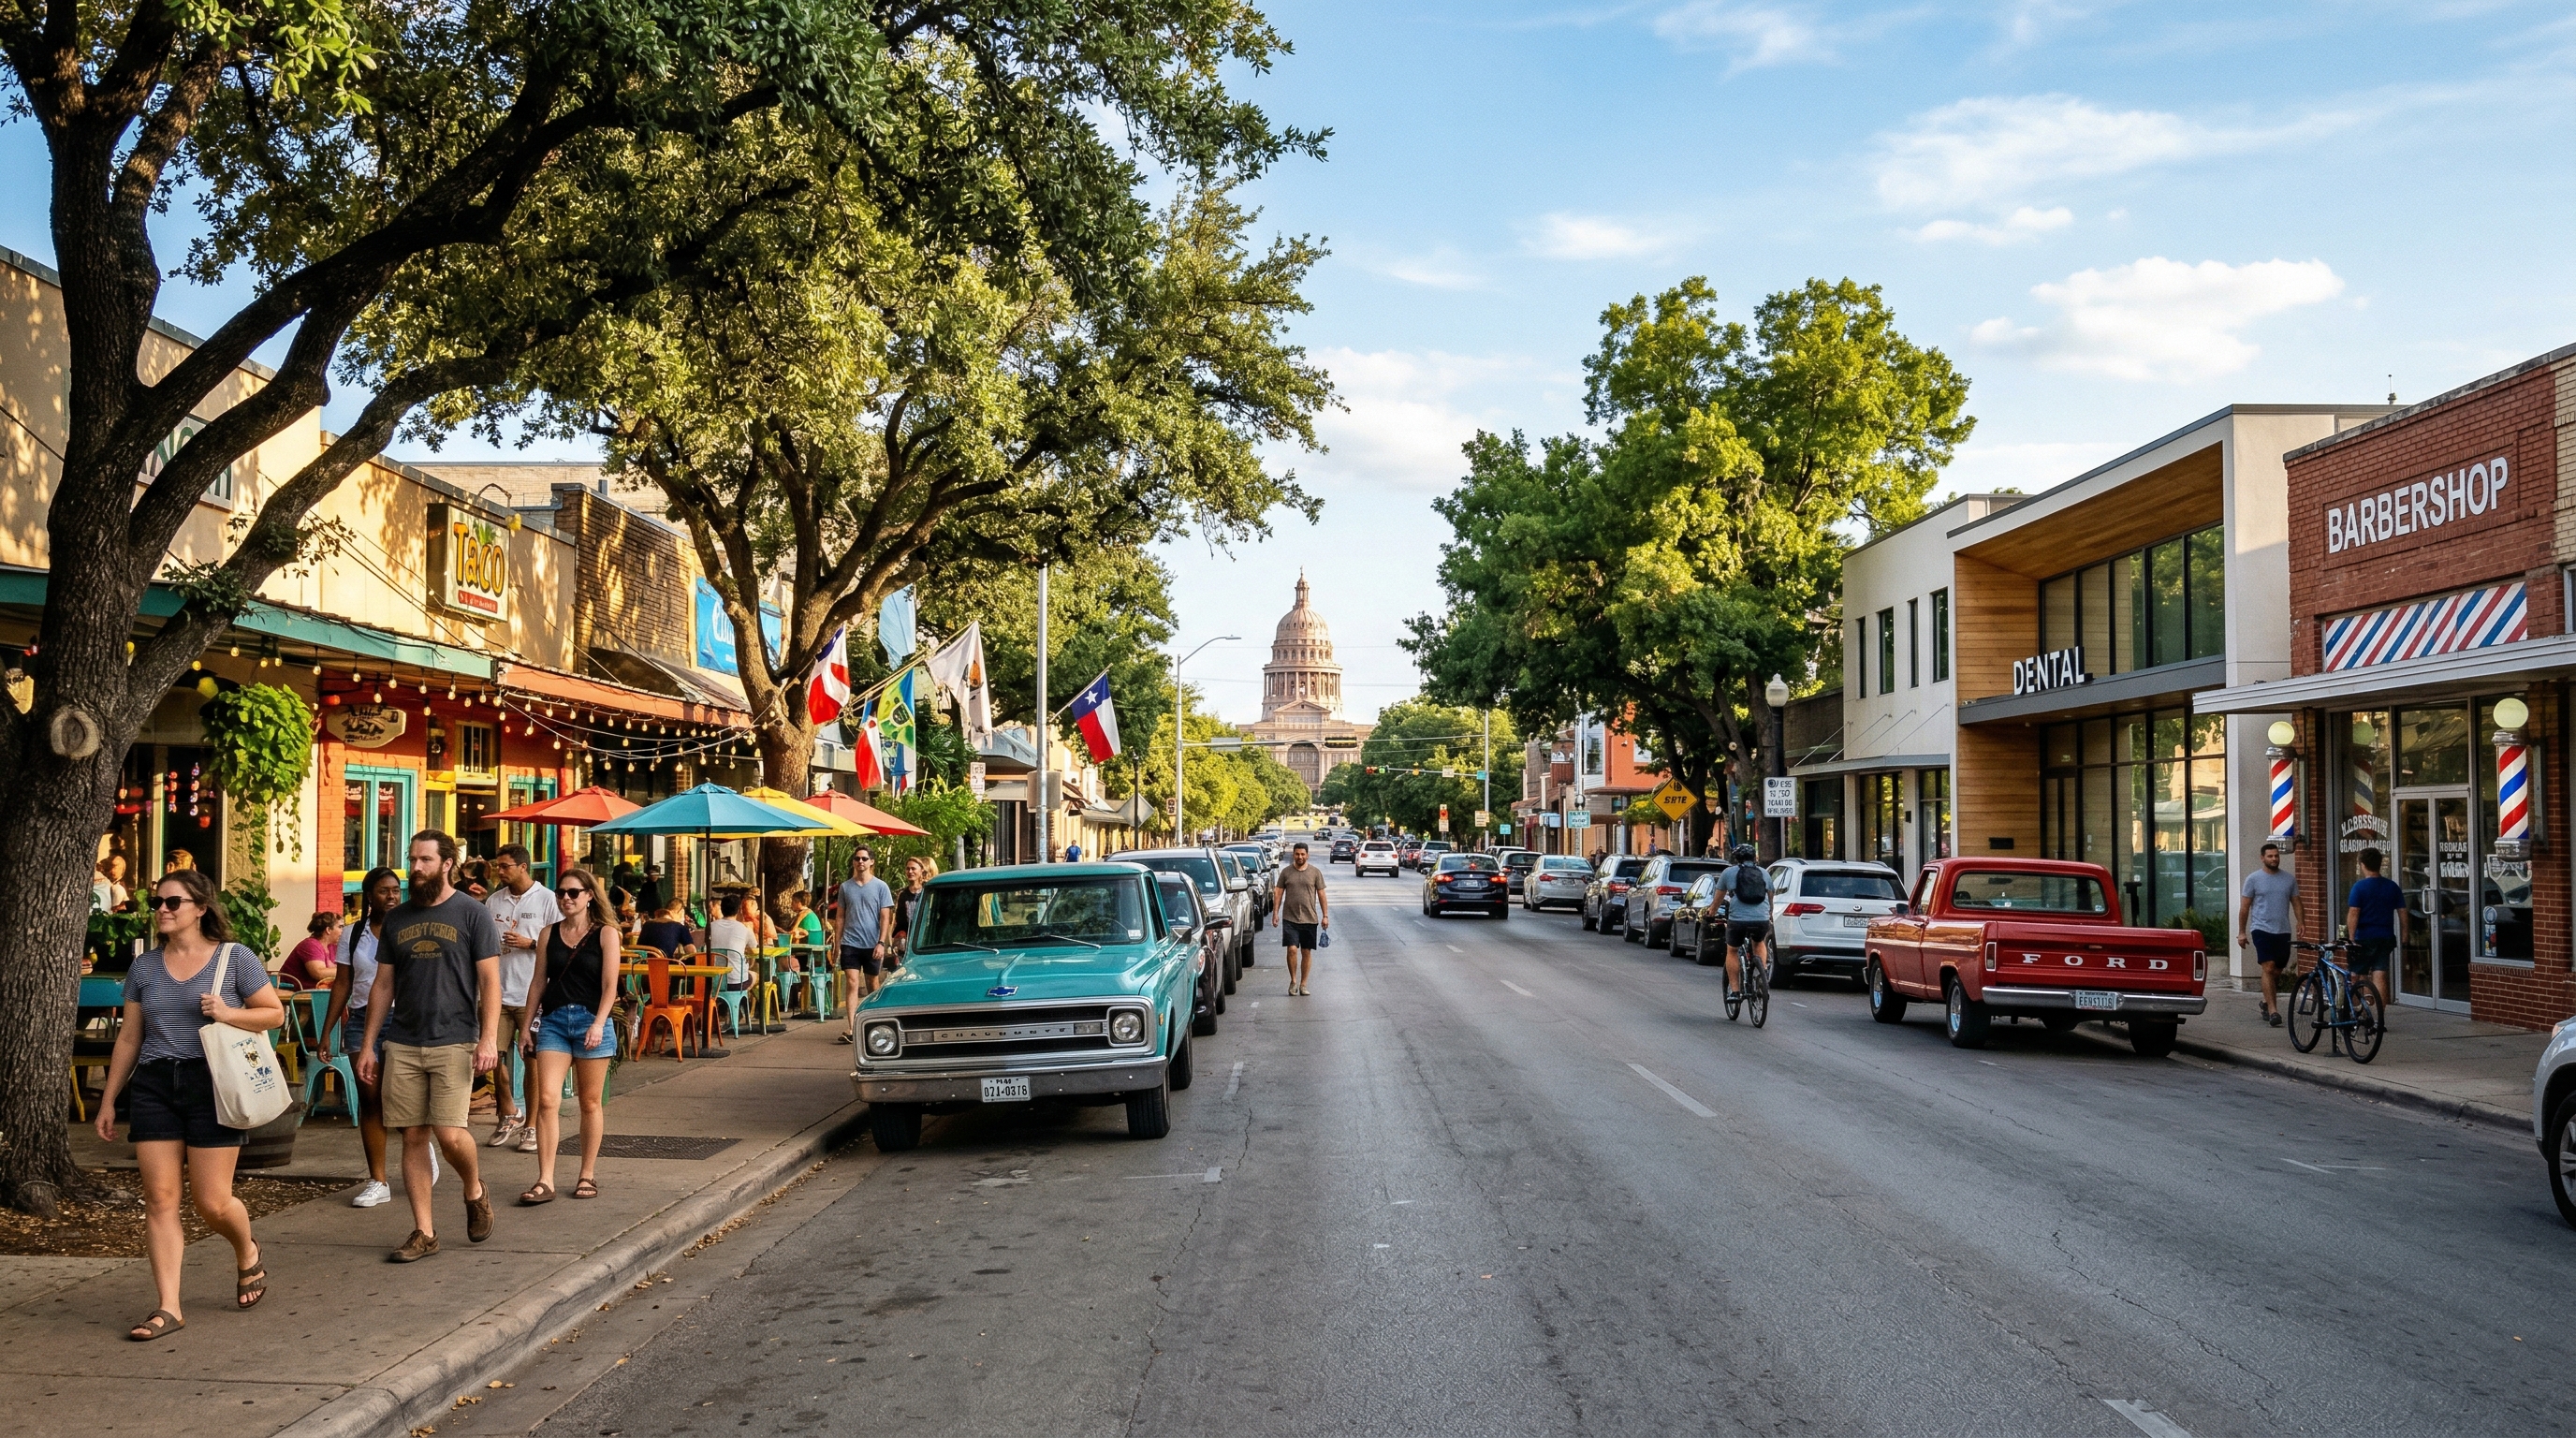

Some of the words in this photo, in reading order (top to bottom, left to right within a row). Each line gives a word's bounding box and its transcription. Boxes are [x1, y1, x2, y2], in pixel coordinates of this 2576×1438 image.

[2328, 456, 2509, 554] BARBERSHOP
[2012, 645, 2086, 696] DENTAL
[2022, 953, 2169, 970] FORD
